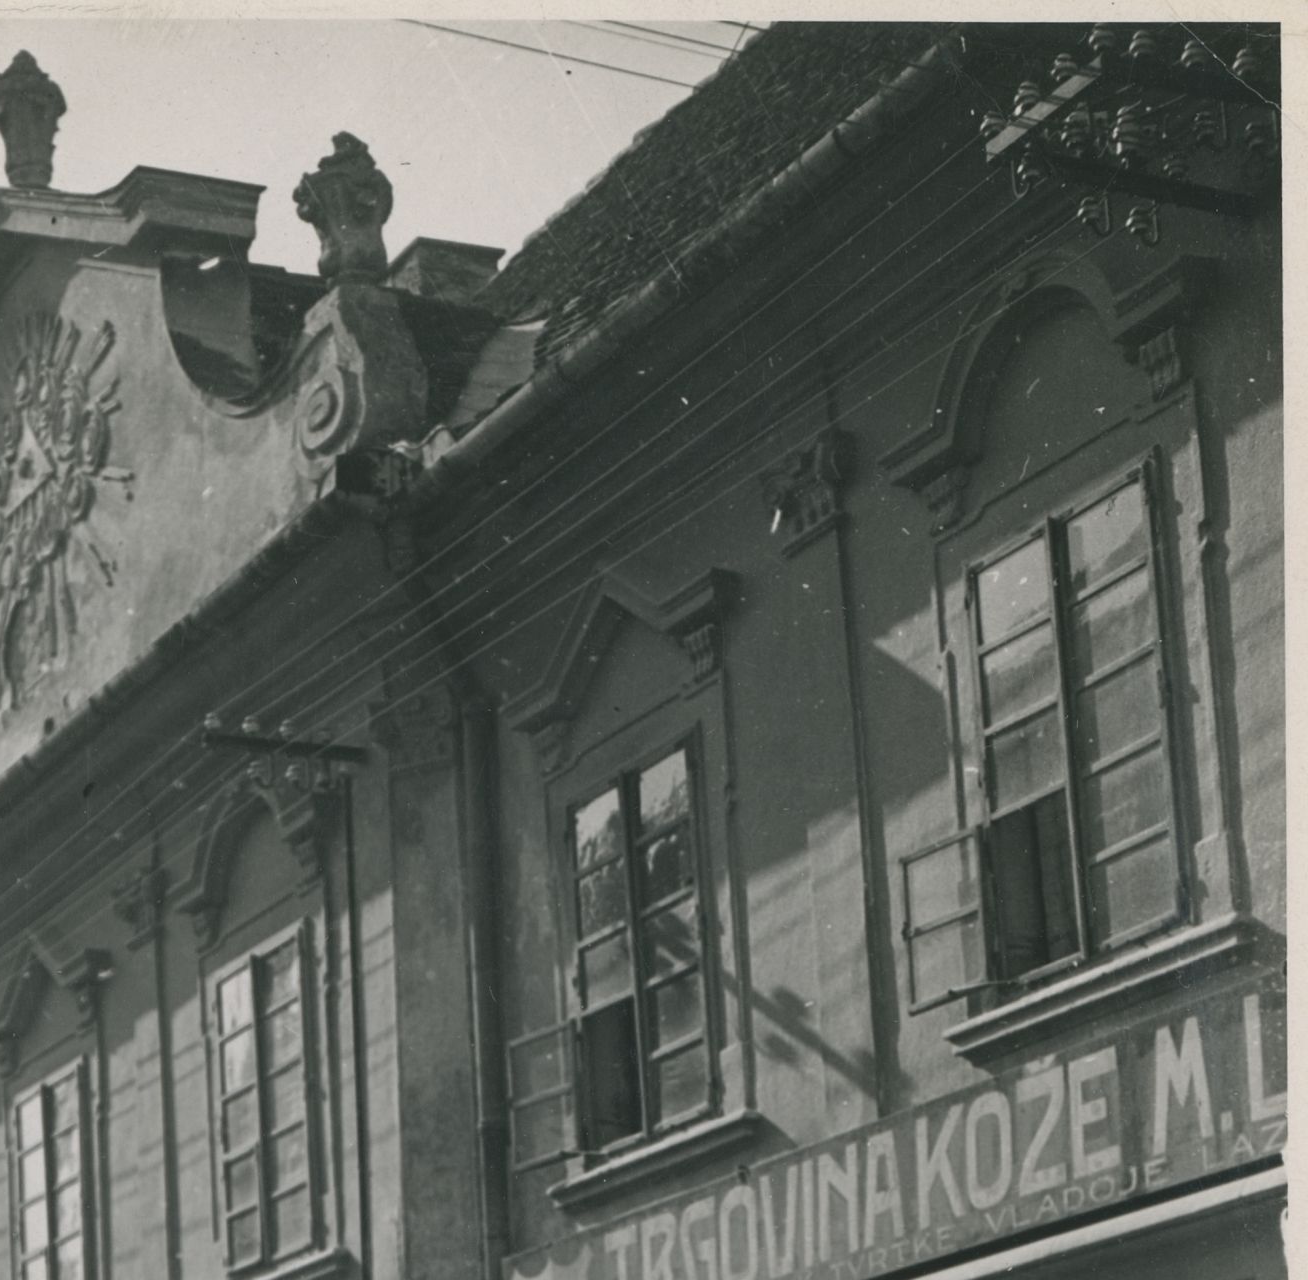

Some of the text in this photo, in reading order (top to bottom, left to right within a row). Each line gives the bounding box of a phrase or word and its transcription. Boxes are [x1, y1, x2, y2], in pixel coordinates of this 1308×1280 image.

[915, 1046, 1123, 1231] KOŽE
[1153, 1016, 1234, 1157] M.
[985, 1156, 1171, 1236] VLADOJE
